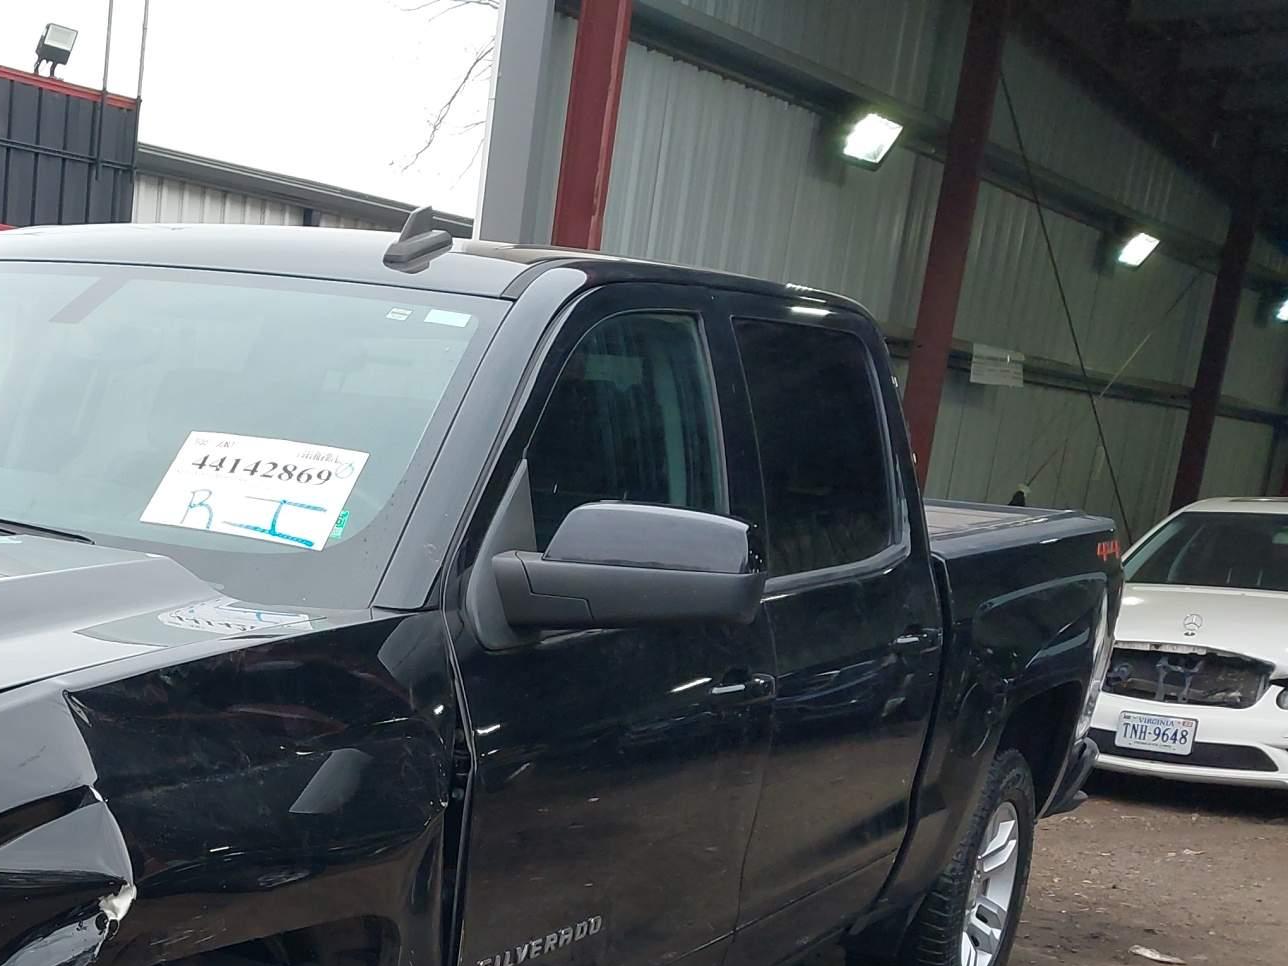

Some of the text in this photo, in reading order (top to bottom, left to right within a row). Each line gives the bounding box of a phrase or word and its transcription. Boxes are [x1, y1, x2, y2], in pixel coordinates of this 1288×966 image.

[191, 454, 332, 486] 44142869
[1138, 716, 1175, 727] VIRGINIA
[1122, 722, 1189, 745] TNH-9648
